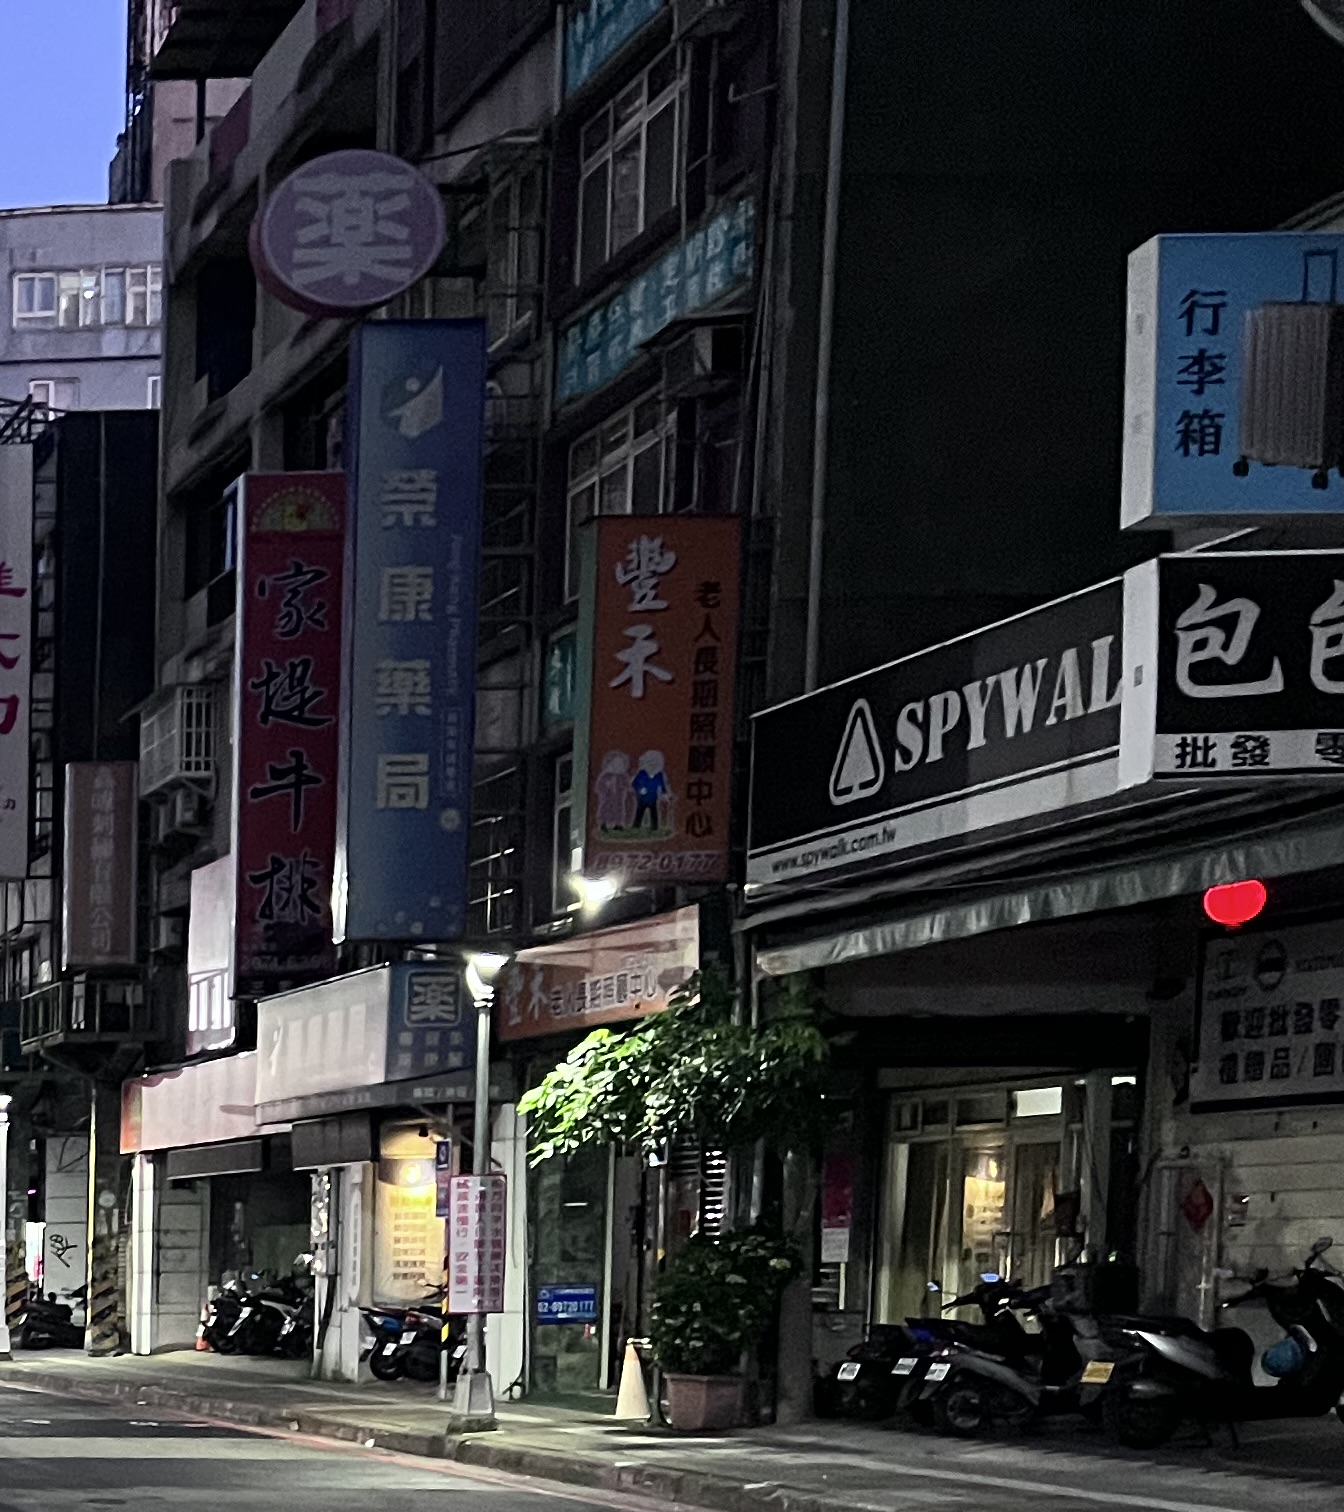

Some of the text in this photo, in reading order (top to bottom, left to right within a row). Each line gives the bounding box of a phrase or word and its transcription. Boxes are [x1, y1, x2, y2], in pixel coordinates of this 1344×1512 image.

[1175, 289, 1228, 458] 行李箱
[609, 534, 678, 699] 豐禾
[685, 581, 721, 838] 老人長期照顧中心
[1175, 735, 1269, 769] 批發
